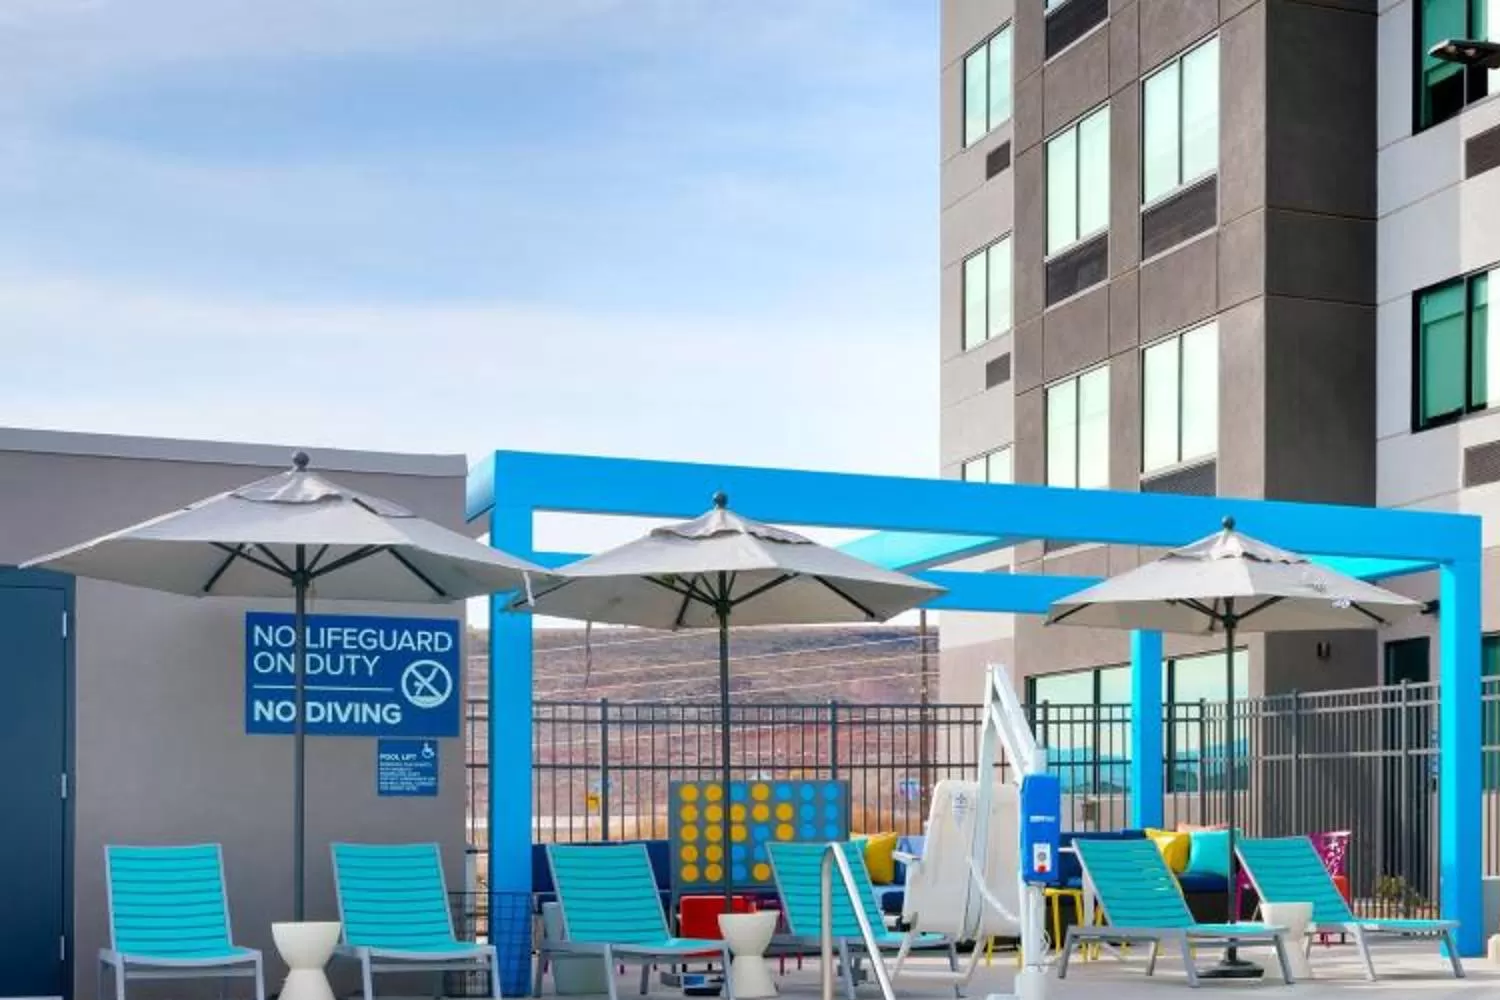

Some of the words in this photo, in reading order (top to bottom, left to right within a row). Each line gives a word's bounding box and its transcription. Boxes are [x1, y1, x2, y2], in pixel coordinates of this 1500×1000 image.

[253, 624, 296, 648] NO
[305, 627, 453, 653] LIFEGUARD
[253, 651, 295, 674] ON
[305, 653, 381, 678] DUTY
[253, 700, 297, 723] NO
[305, 701, 402, 725] DIVING
